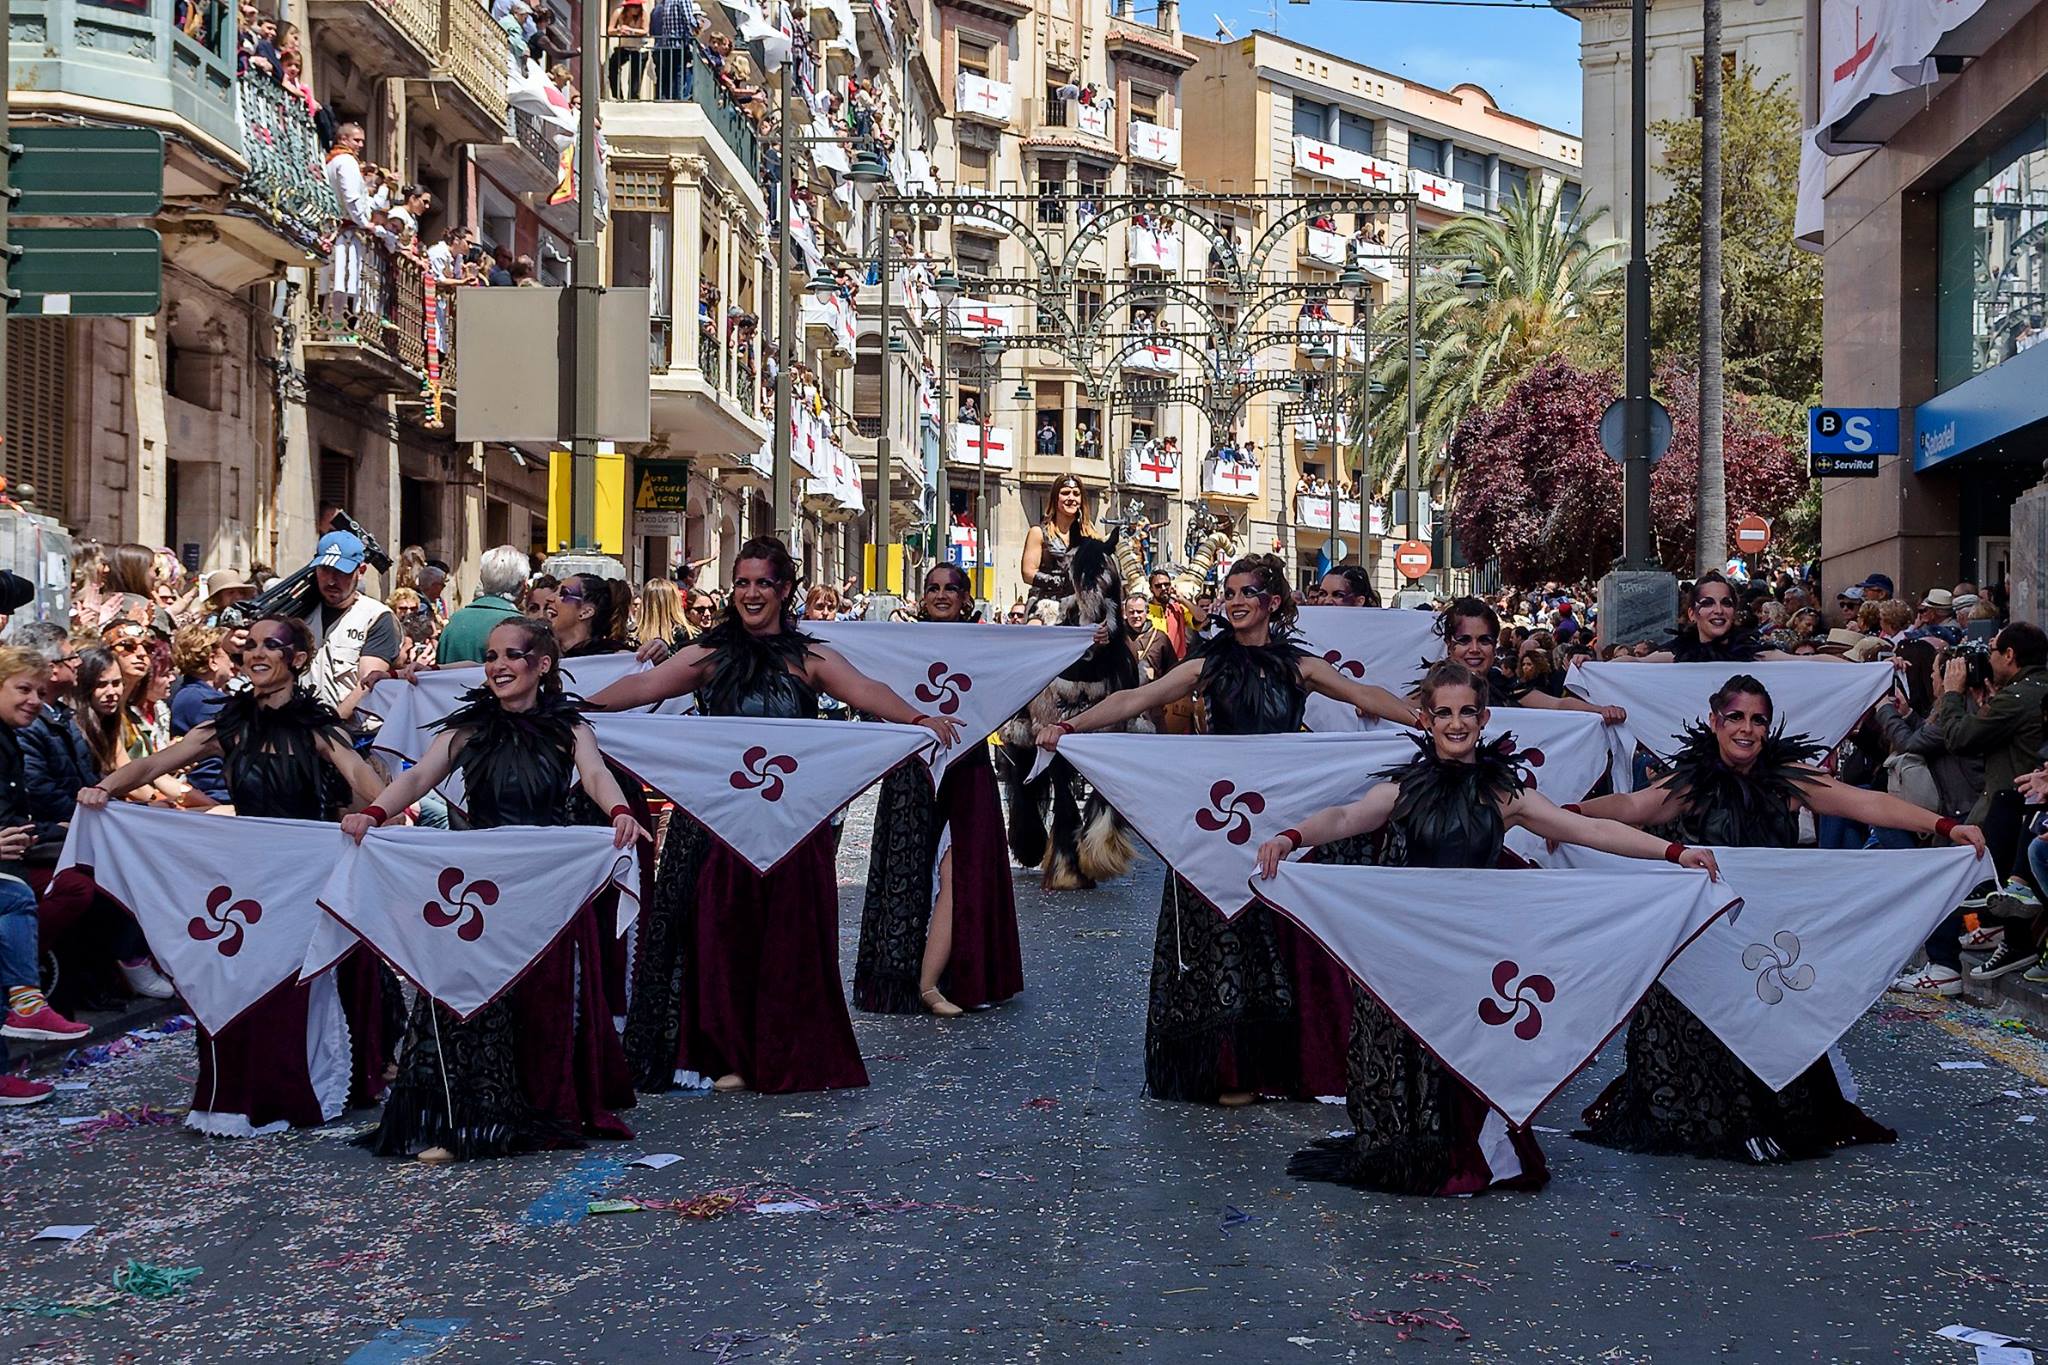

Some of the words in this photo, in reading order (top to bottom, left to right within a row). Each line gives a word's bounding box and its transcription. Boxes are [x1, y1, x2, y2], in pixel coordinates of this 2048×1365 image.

[1823, 417, 1835, 431] B
[1844, 416, 1872, 452] S
[1925, 421, 1955, 457] Sabadell
[1834, 460, 1874, 469] ServiRed
[346, 629, 364, 640] 106
